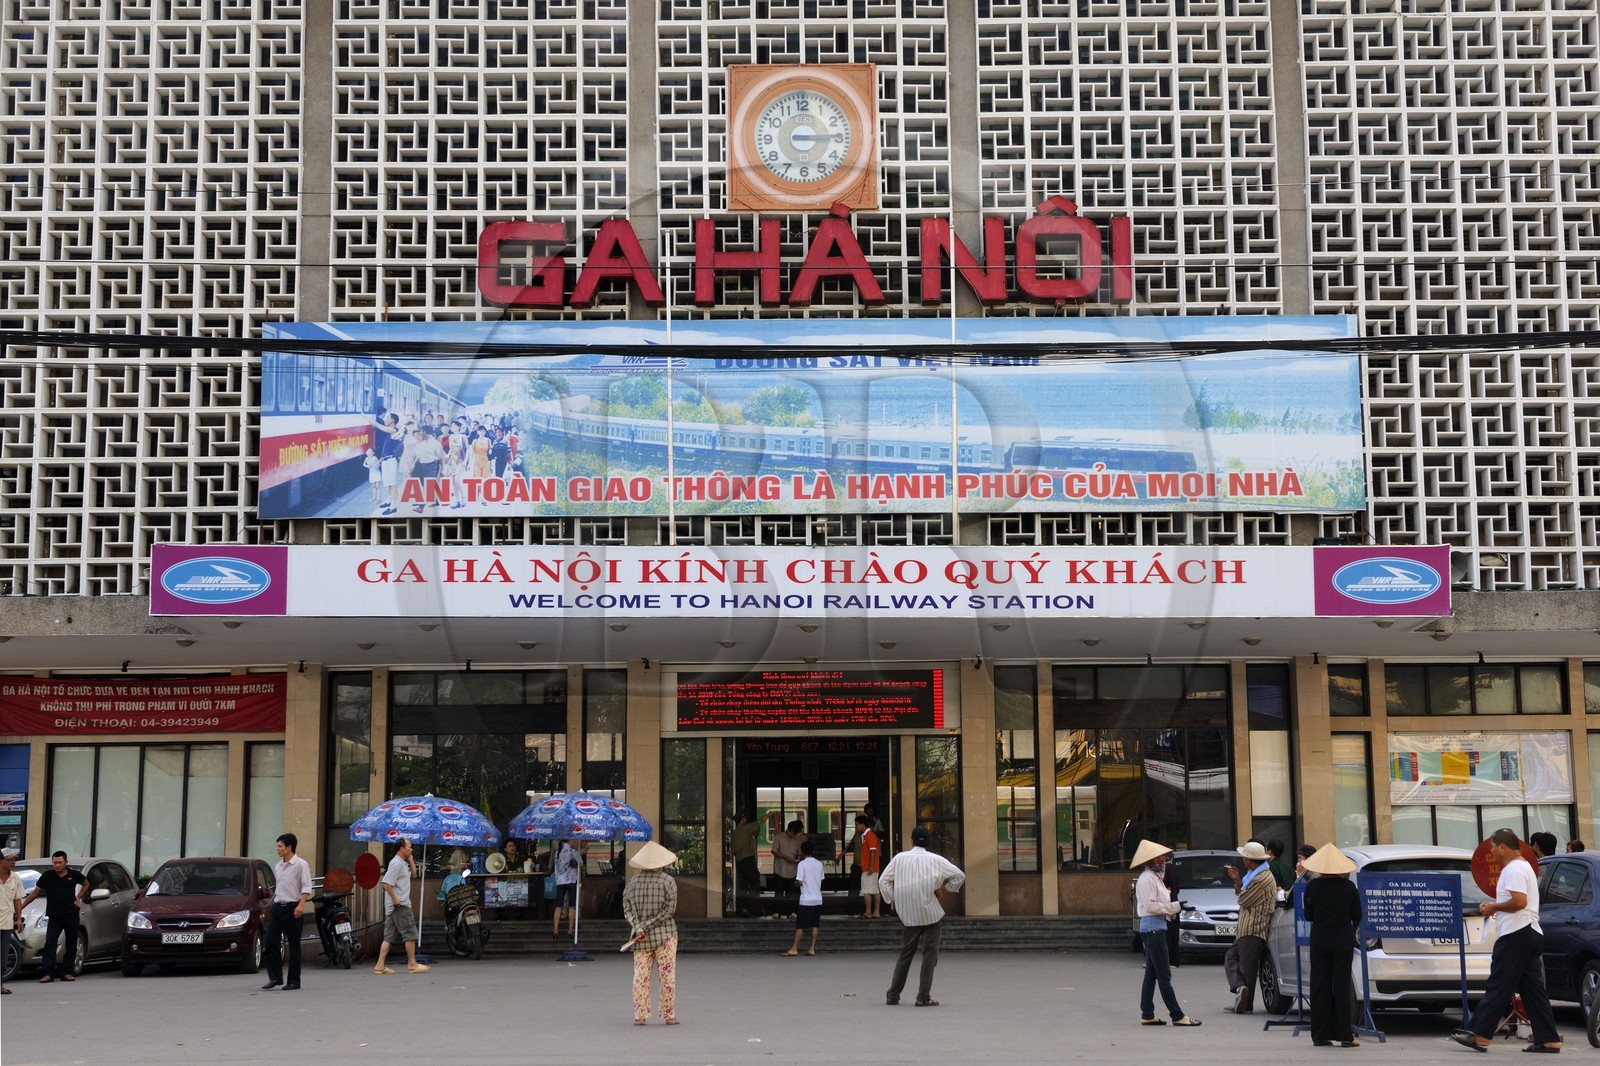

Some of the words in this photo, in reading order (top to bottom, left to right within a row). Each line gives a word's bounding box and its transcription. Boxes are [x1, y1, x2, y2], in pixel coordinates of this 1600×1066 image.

[780, 105, 791, 116] 11
[796, 100, 809, 111] 12
[818, 104, 823, 115] 1
[768, 117, 782, 128] 10
[829, 116, 838, 127] 2
[763, 134, 773, 145] 9
[834, 133, 844, 143] 3
[768, 151, 779, 161] 8
[828, 149, 839, 160] 4
[783, 163, 792, 174] 7
[800, 166, 809, 177] 6
[817, 163, 826, 173] 5
[478, 218, 666, 309] GA
[694, 201, 886, 308] HÀ
[279, 442, 309, 468] ĐƯỜNG
[310, 437, 327, 458] SẮT
[328, 437, 347, 454] VIỆT
[348, 434, 369, 447] NAM
[400, 478, 451, 502] AN
[462, 473, 556, 502] TOÀN
[569, 477, 651, 501] GIAO
[663, 471, 781, 500] THÔNG
[793, 469, 836, 500] LÀ
[848, 475, 945, 504] HẠNH
[957, 469, 1053, 499] PHÚC
[1065, 462, 1137, 498] CỦA
[1149, 473, 1216, 502] MỌI
[1229, 467, 1304, 497] NHÀ
[357, 558, 428, 583] GA
[442, 550, 515, 583] HÀ
[529, 551, 622, 591] NỘI
[638, 551, 769, 584] KÍNH
[786, 551, 928, 584] CHÀO
[944, 551, 1051, 590] QUÝ
[1065, 551, 1247, 584] KHÁCH
[201, 576, 222, 584] VNR
[1371, 576, 1392, 584] VNR
[508, 594, 661, 609] WELCOME
[671, 594, 710, 609] TO
[721, 594, 812, 609] HANOI
[823, 594, 959, 609] RAILWAY
[968, 594, 1094, 610] STATION
[2, 685, 15, 695] GA
[33, 684, 51, 697] NỘI
[192, 686, 212, 694] CHO
[40, 700, 72, 711] KHÔNG
[75, 701, 93, 711] THU
[96, 700, 111, 711] PHÍ
[114, 701, 145, 711] TRONG
[148, 701, 175, 713] PHẠM
[178, 701, 187, 710] VI
[215, 700, 236, 710] 7KM
[54, 717, 86, 729] ĐIỆN
[91, 718, 137, 729] THOẠI:
[140, 717, 220, 727] 04-39423949
[746, 743, 762, 751] Yên
[765, 743, 790, 752] Trung
[165, 934, 200, 943] 30K-5787
